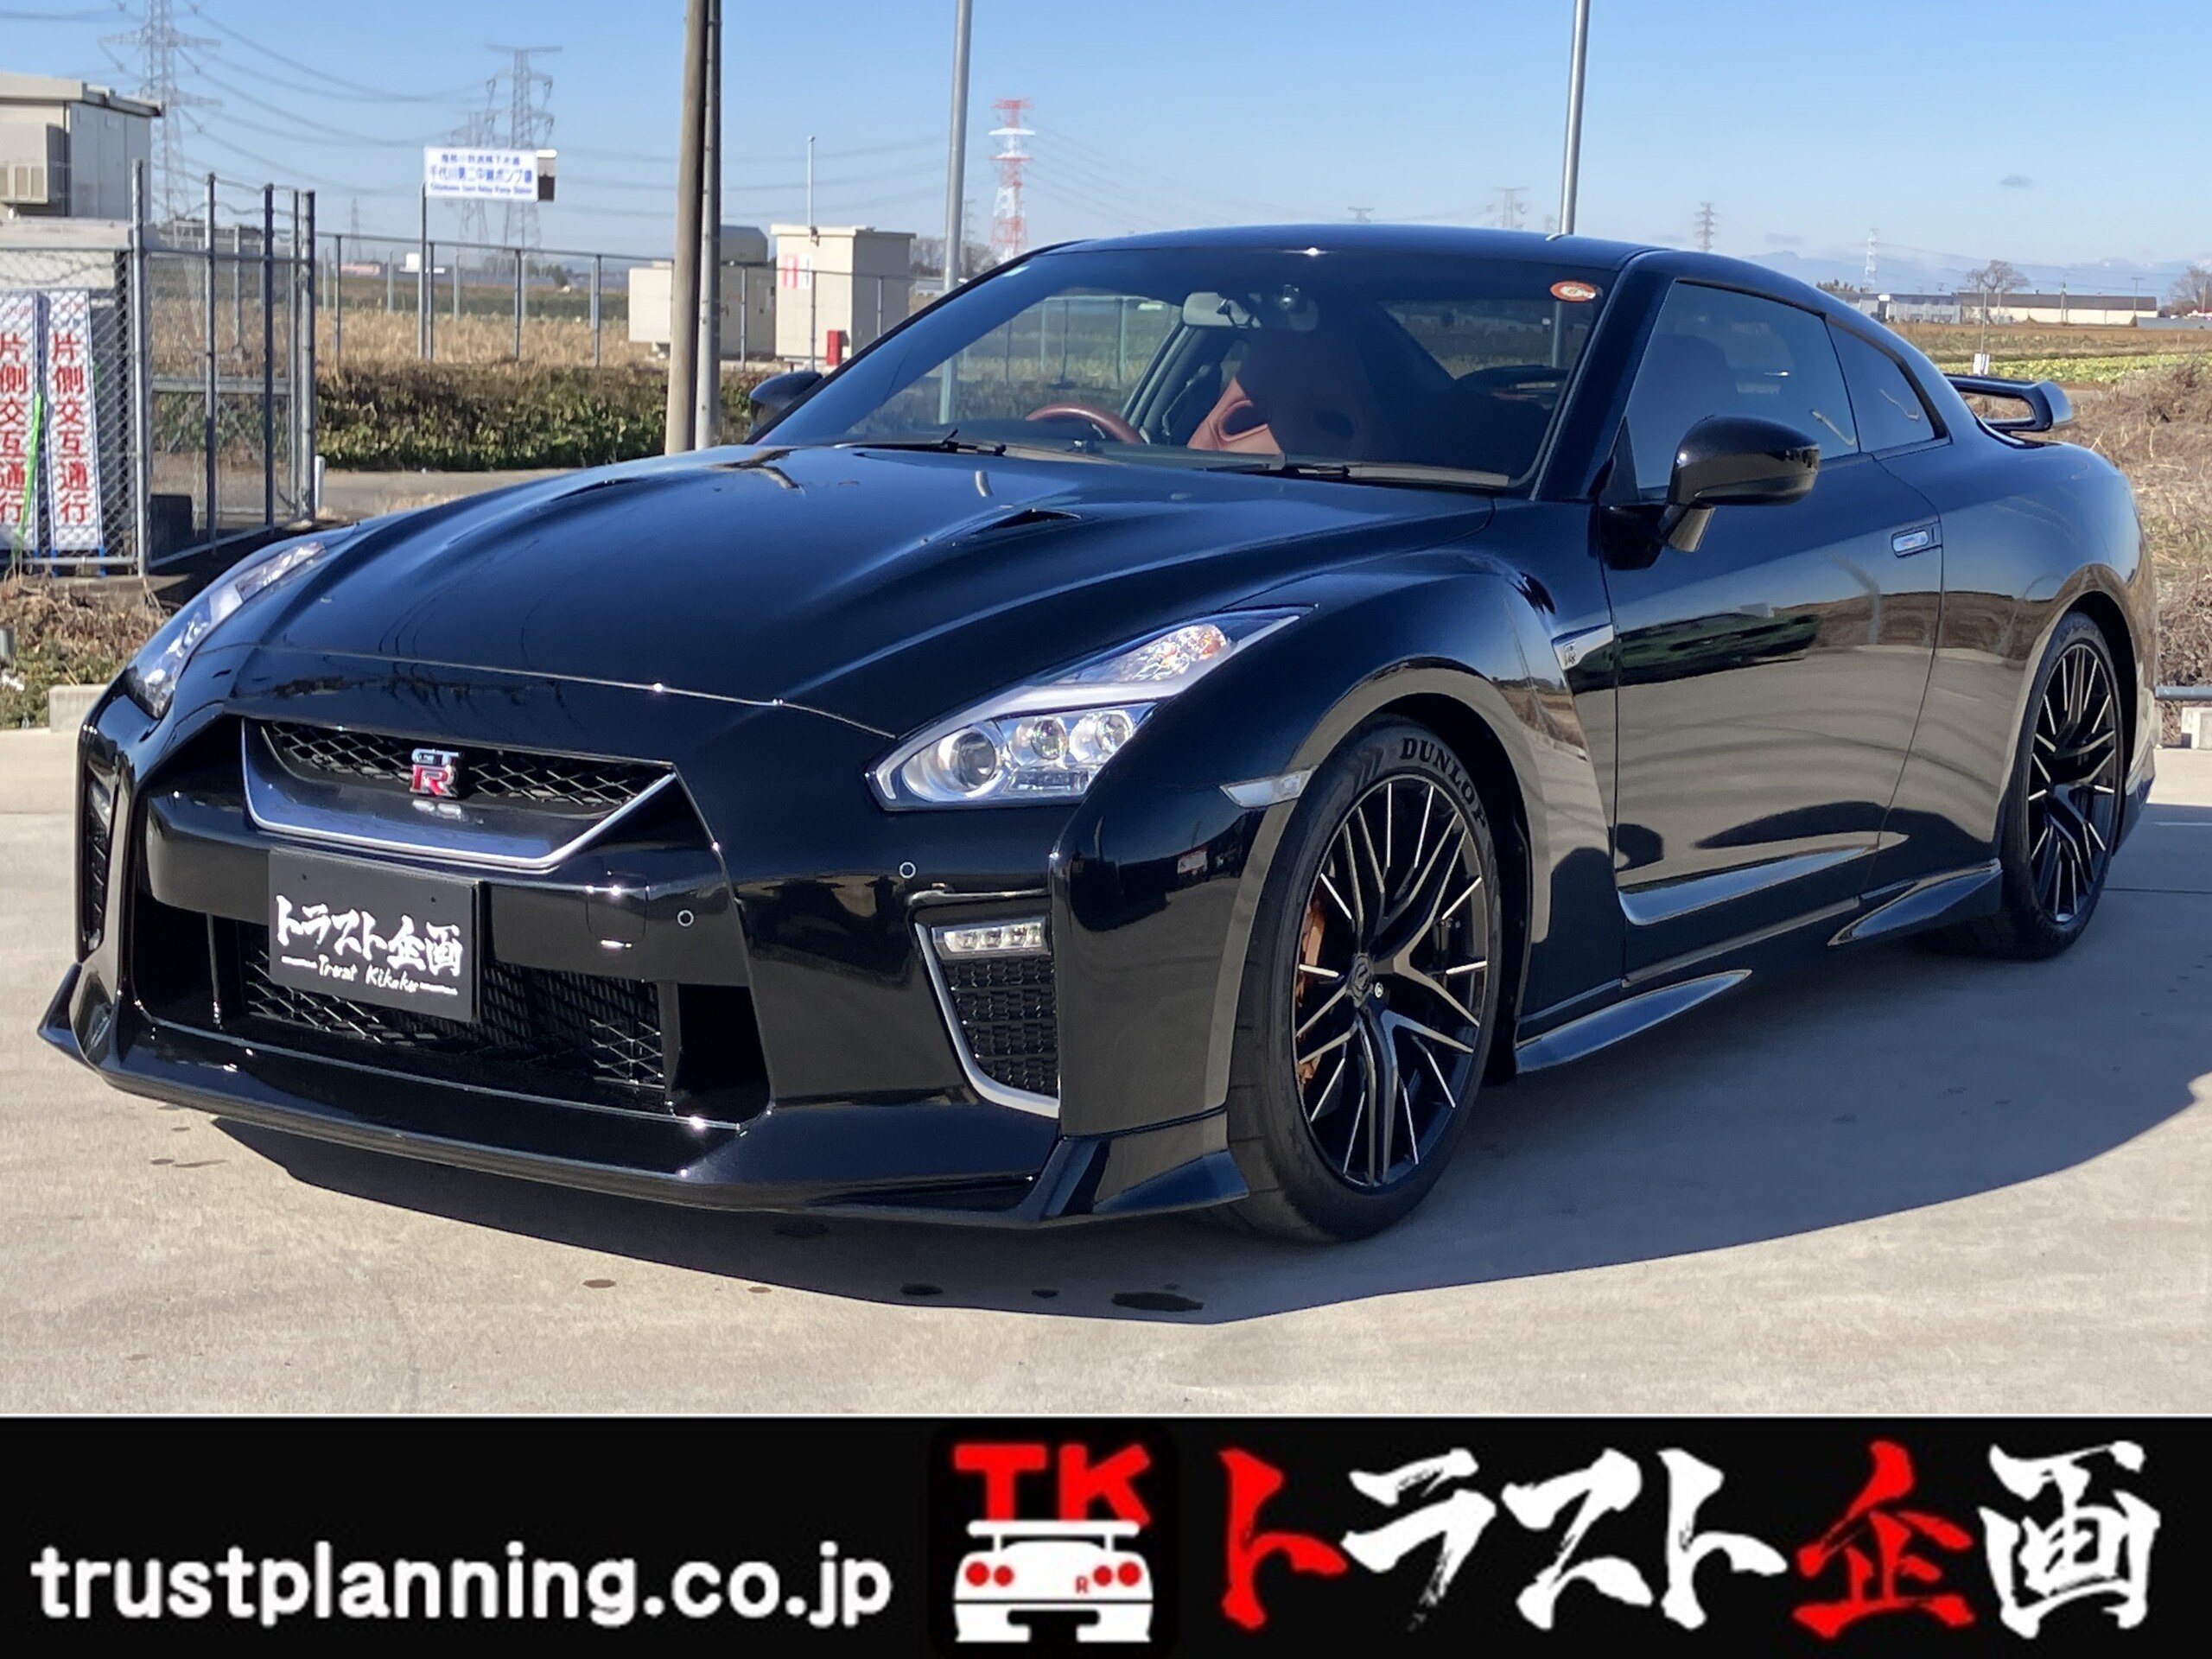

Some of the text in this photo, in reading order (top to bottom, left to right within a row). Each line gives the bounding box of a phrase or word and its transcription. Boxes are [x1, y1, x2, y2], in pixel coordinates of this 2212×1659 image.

[0, 332, 28, 523] 片側交互通行
[53, 332, 88, 523] 片側交互通行
[1400, 737, 1486, 828] DUNLOP
[276, 894, 463, 977] トラスト企画
[318, 953, 420, 994] Trust Kikaku
